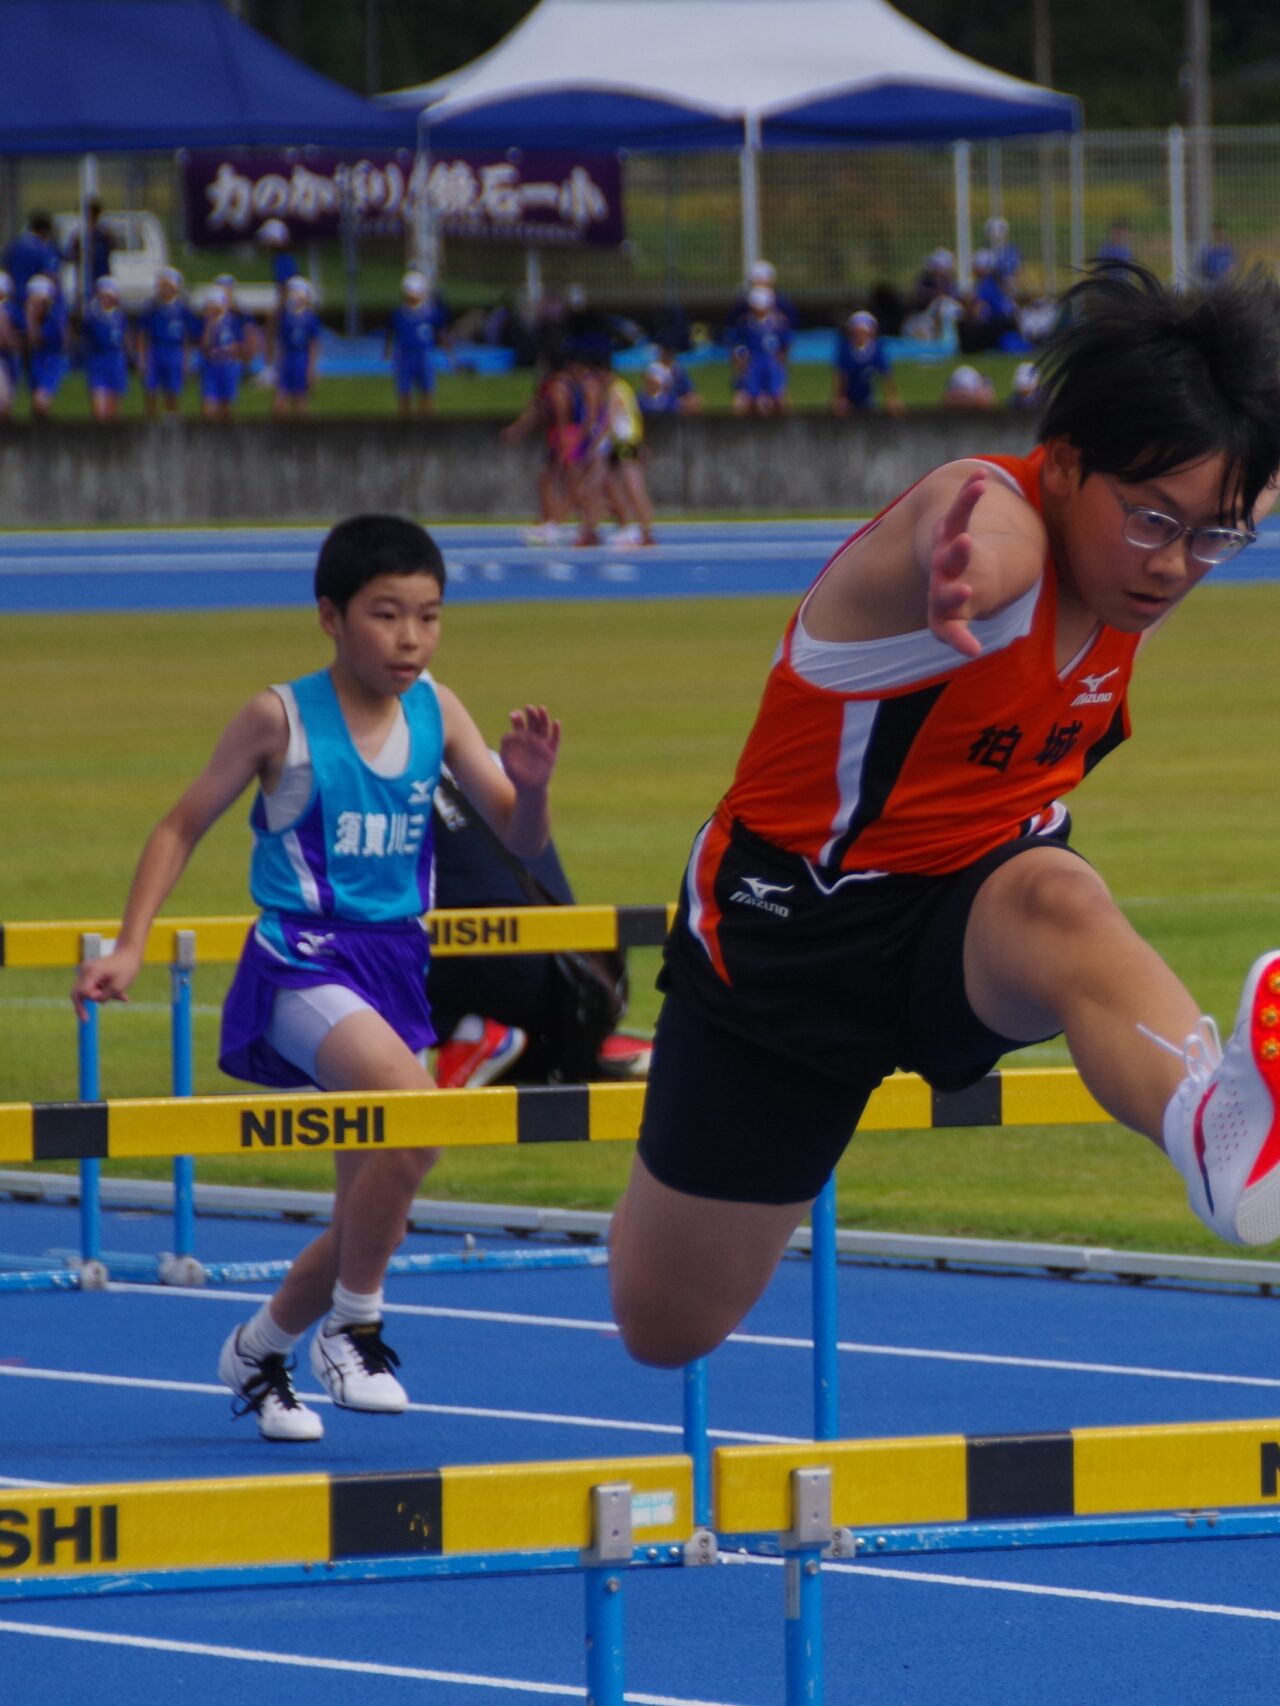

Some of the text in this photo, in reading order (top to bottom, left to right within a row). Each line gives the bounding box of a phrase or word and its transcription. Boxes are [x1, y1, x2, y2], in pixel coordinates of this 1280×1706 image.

[967, 719, 1083, 773] 柏城
[334, 811, 424, 857] 須賀川三
[241, 1107, 385, 1147] NISHI
